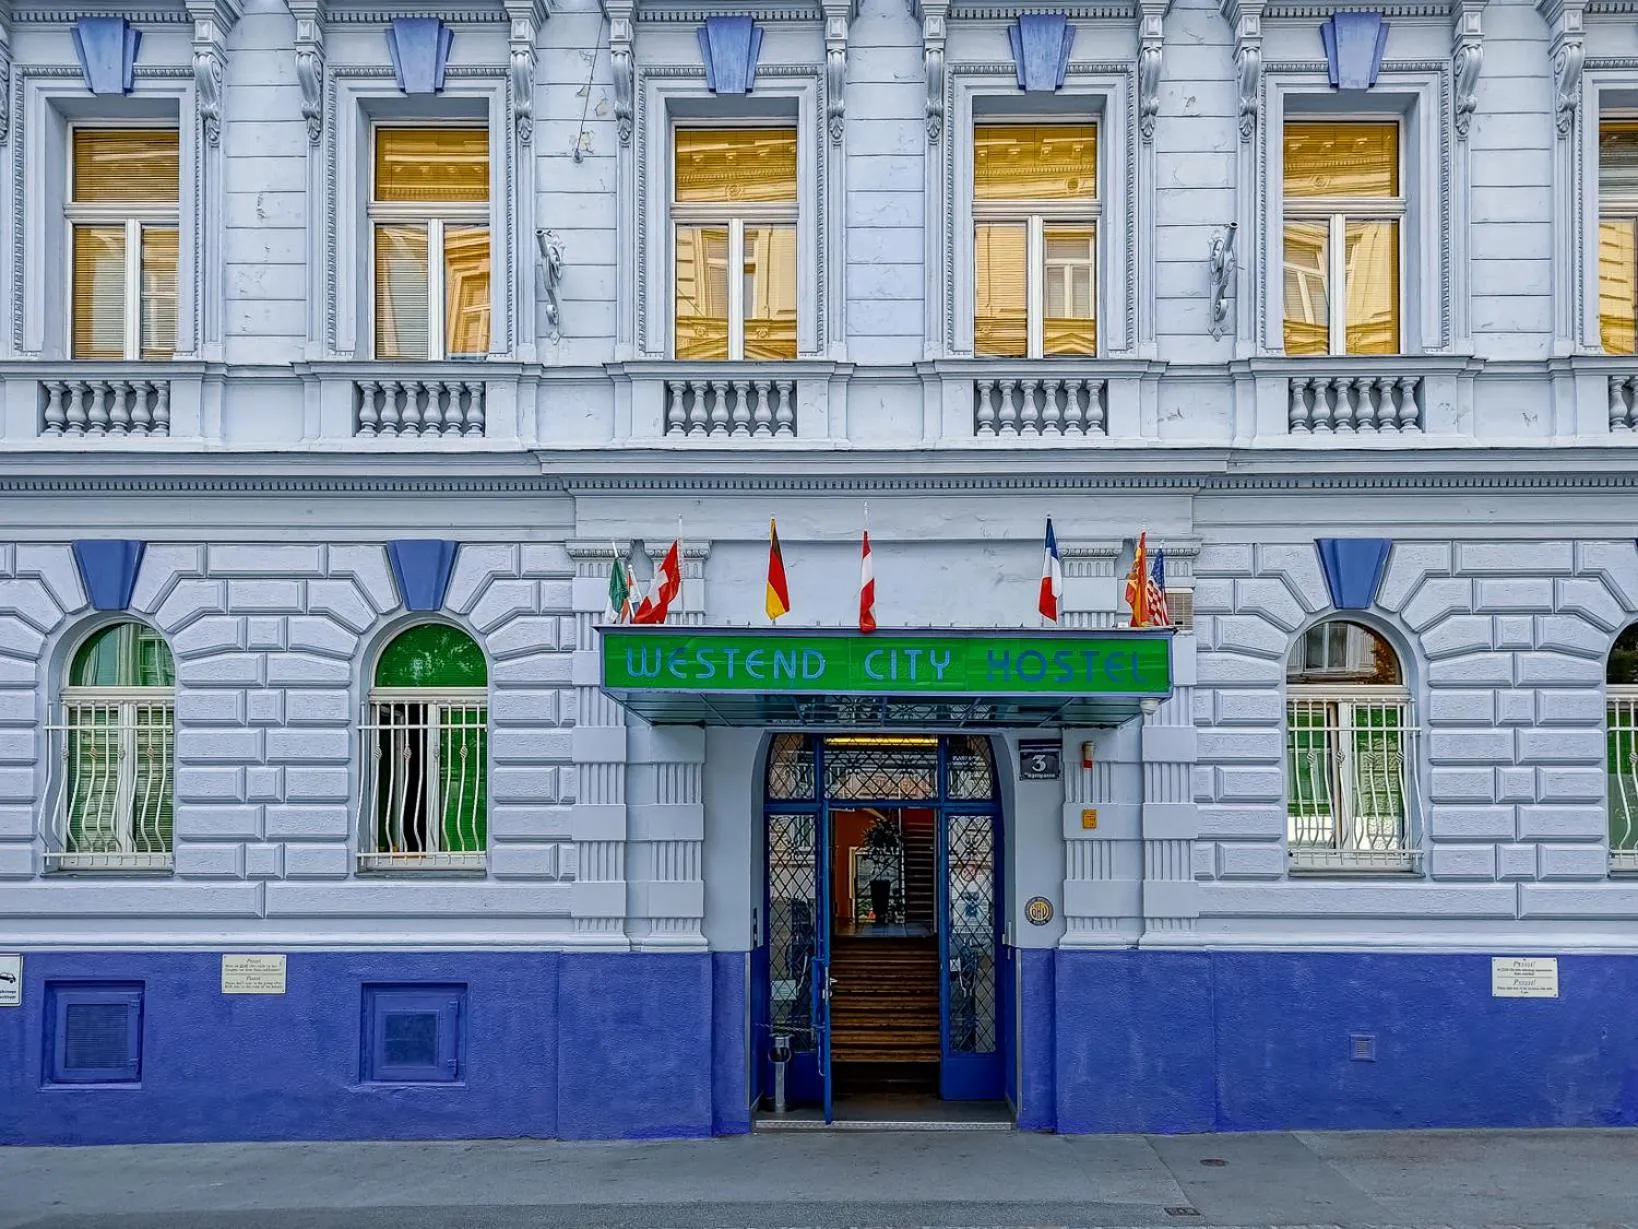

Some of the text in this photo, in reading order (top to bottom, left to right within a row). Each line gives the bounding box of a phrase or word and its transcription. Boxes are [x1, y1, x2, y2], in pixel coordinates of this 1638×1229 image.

[626, 646, 1149, 682] WESTEND CITY HOSTEL
[1032, 754, 1046, 771] 3
